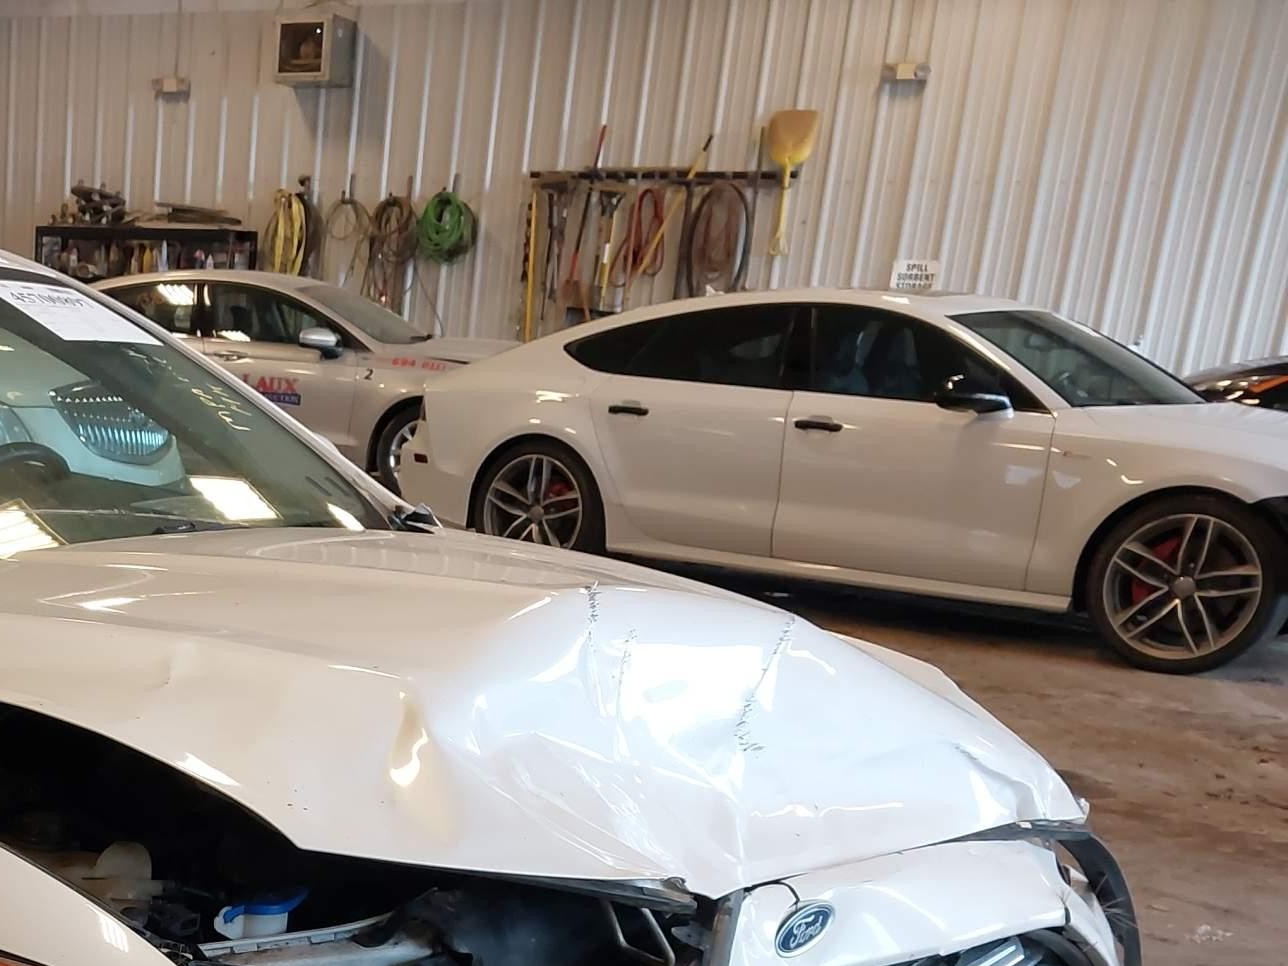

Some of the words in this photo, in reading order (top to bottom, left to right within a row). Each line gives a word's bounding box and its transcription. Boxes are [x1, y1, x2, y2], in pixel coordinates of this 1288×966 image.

[905, 263, 928, 272] SPILL
[896, 272, 936, 282] SORBENT
[363, 367, 374, 380] 2
[789, 914, 824, 949] Ford
